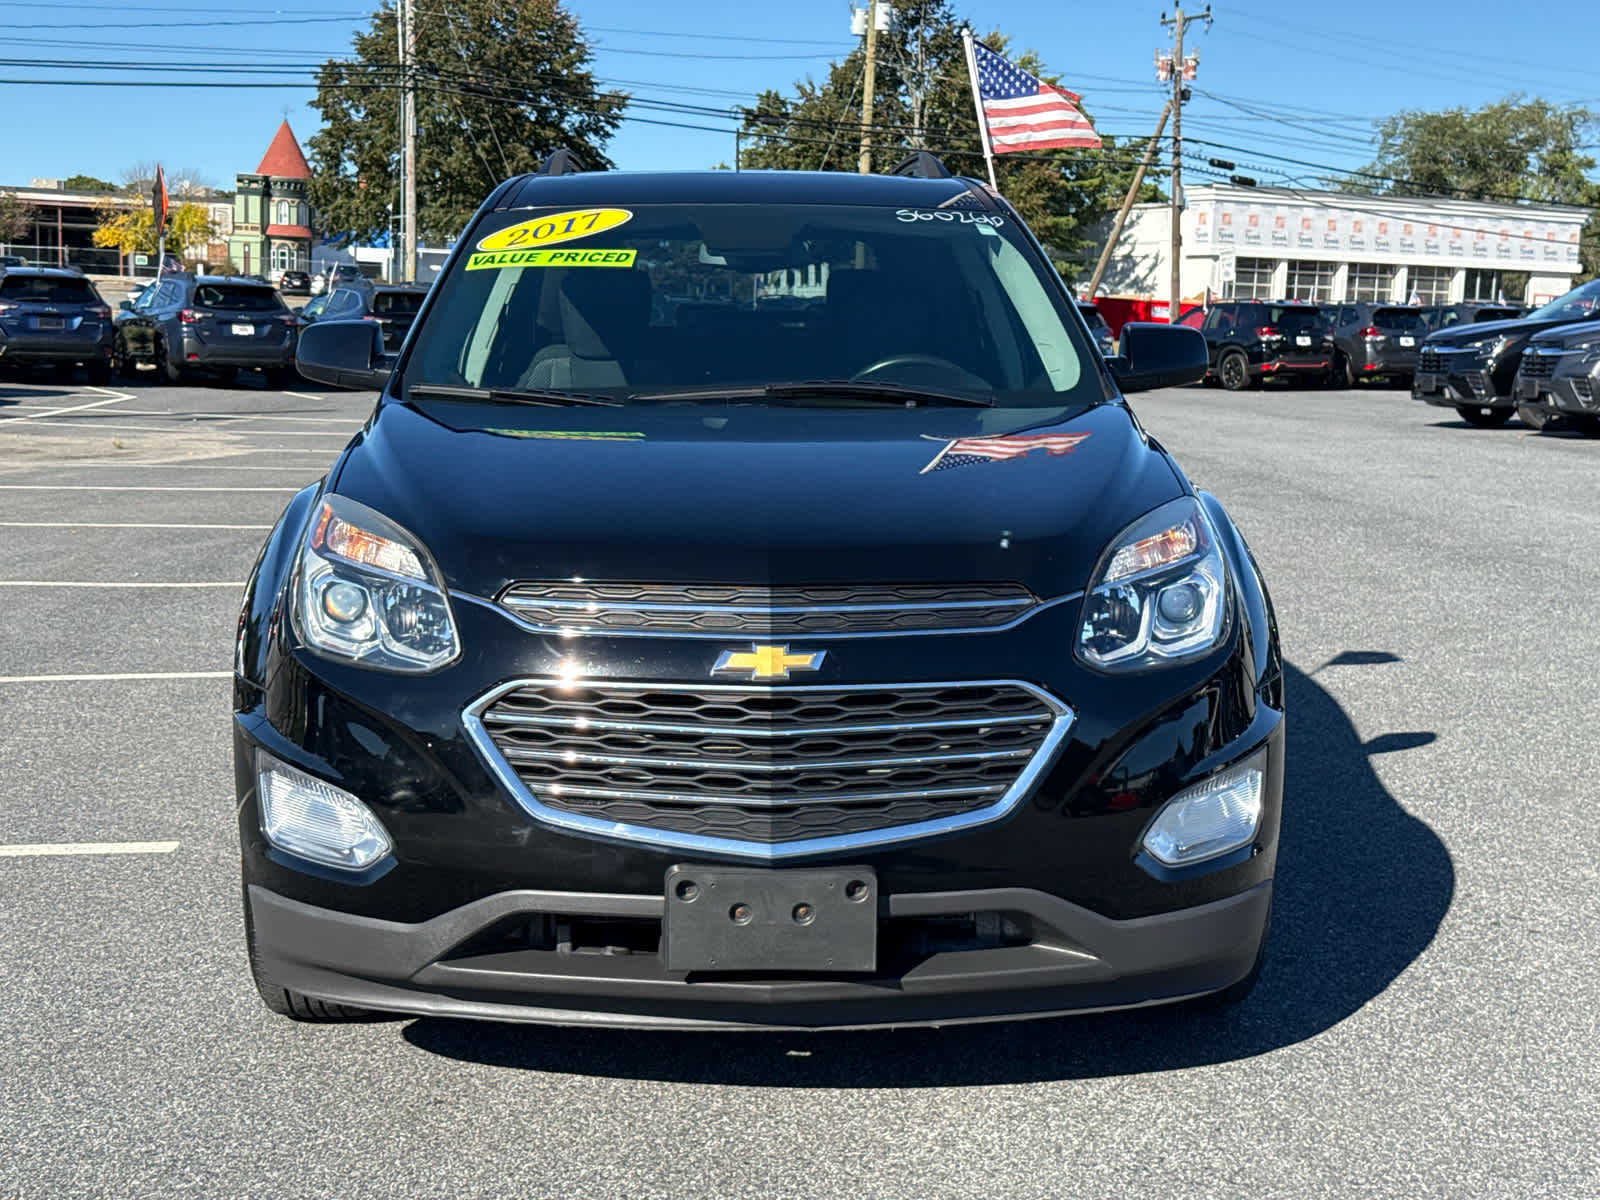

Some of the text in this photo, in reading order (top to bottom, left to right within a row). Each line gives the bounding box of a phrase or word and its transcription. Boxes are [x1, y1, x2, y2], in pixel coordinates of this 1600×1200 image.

[505, 212, 603, 247] 2017
[473, 252, 631, 266] VALUE PRICED
